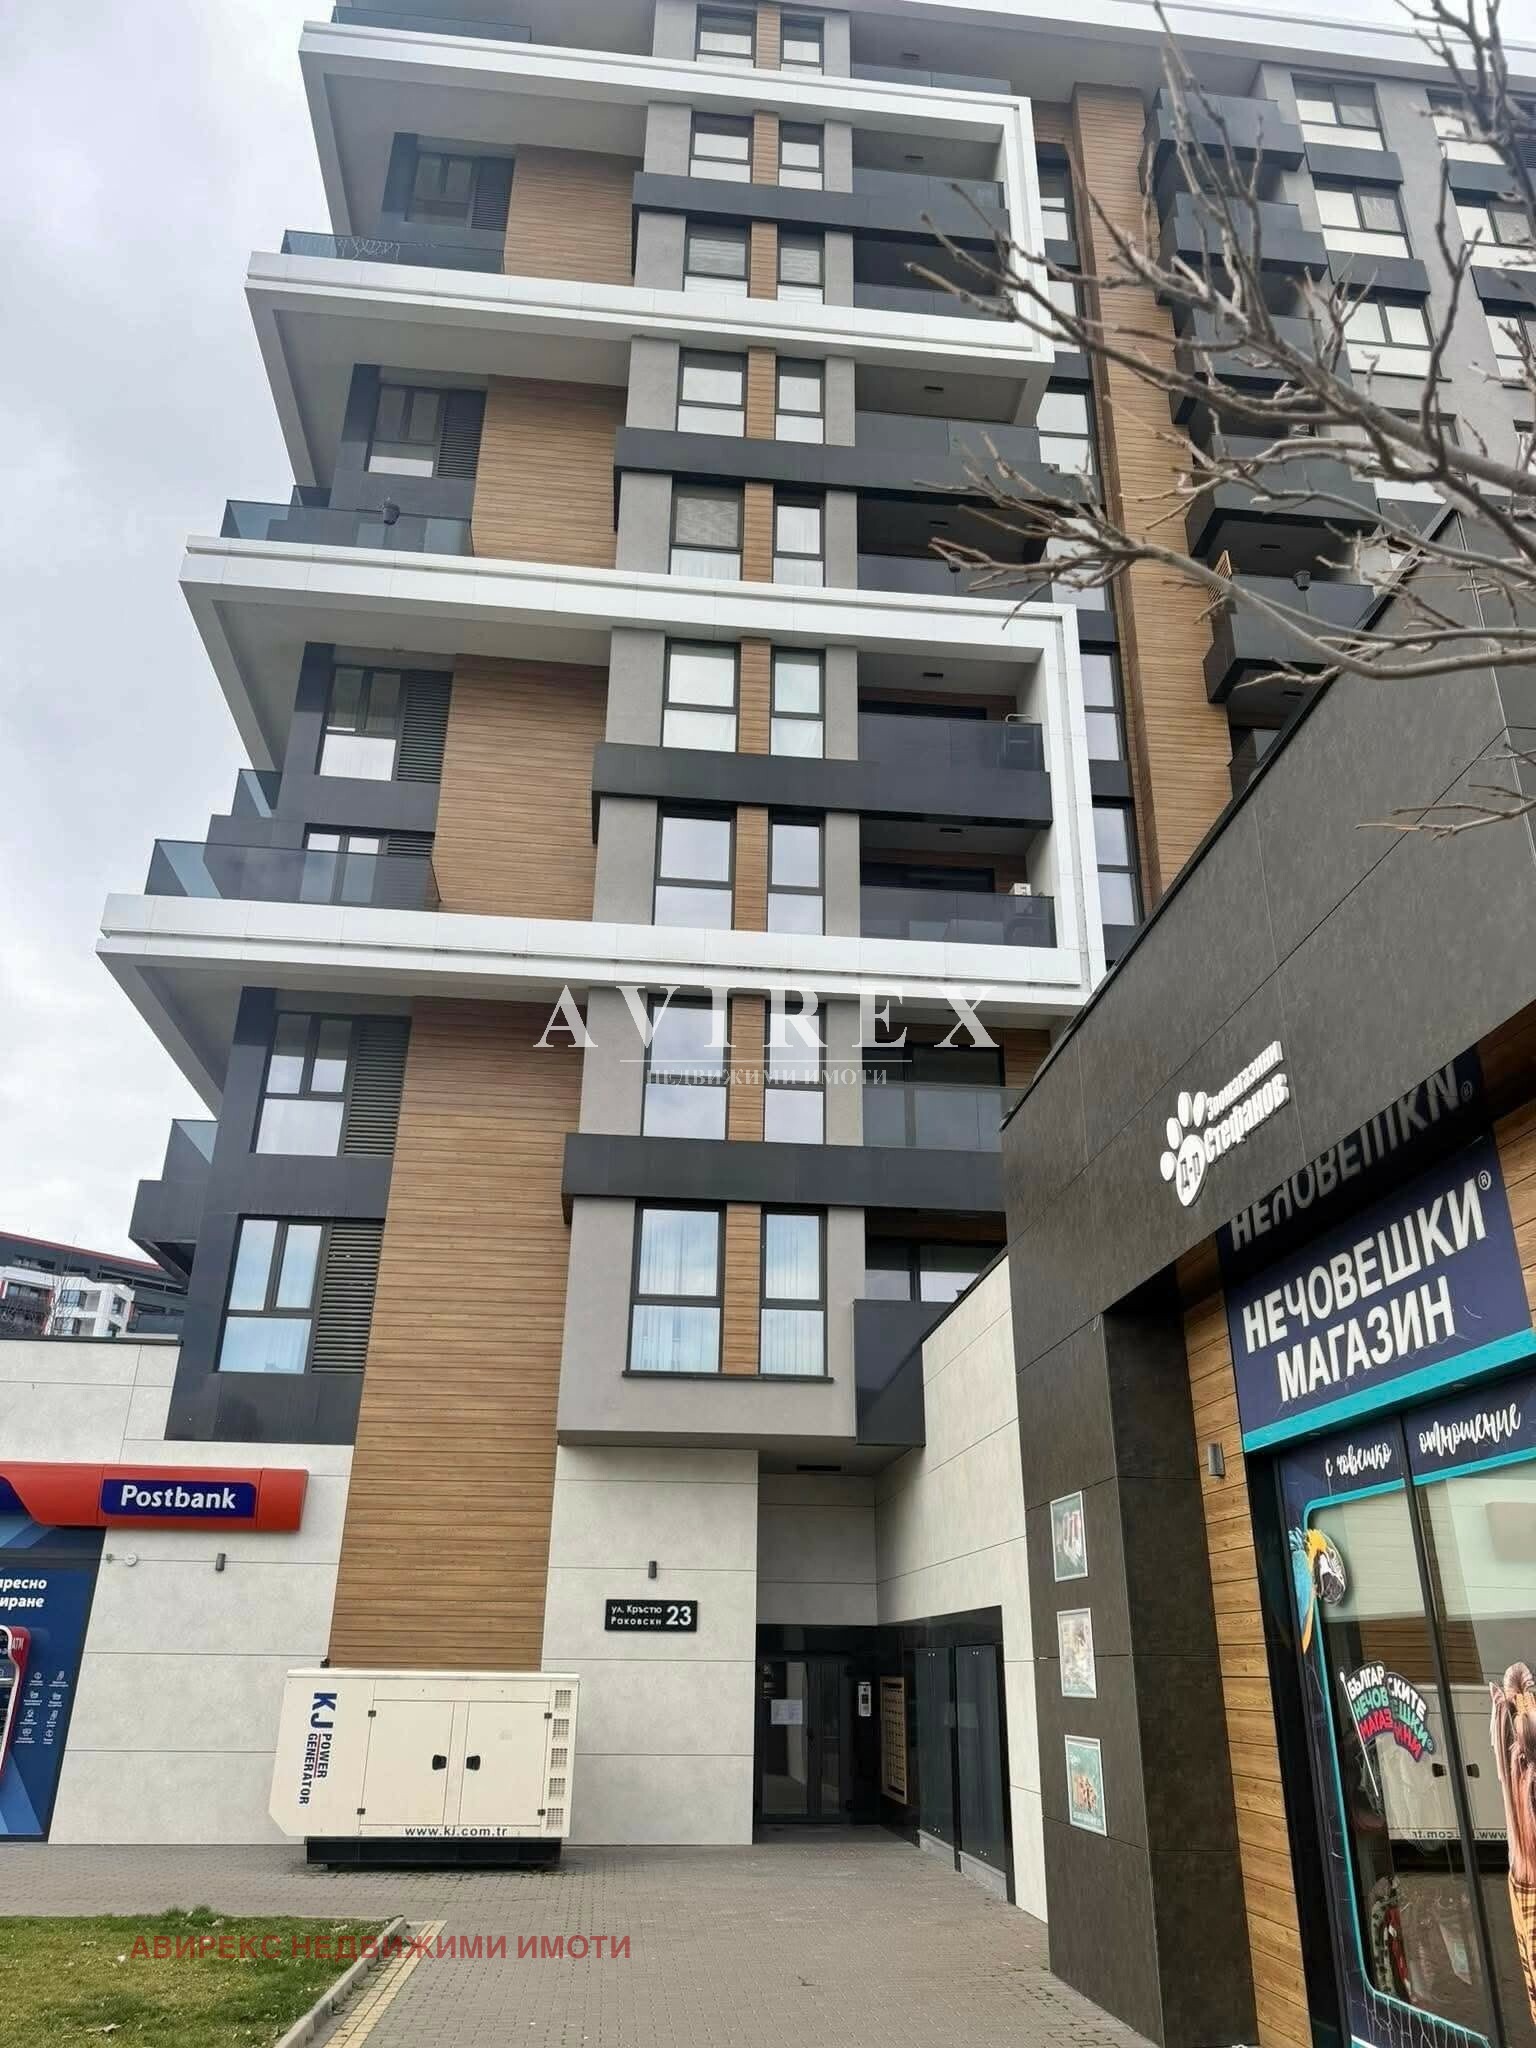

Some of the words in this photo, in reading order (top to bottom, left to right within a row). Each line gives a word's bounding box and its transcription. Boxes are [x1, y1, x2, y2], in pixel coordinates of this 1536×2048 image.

[1276, 1275, 1456, 1402] МАГАЗИН
[1336, 1442, 1392, 1477] човешко
[1418, 1403, 1521, 1457] отношение
[121, 1484, 236, 1509] Postbank
[611, 1606, 625, 1615] ул.
[626, 1605, 662, 1616] Кръстю
[666, 1605, 692, 1626] 23
[611, 1616, 662, 1625] Раковски
[310, 1692, 338, 1729] KJ
[1347, 1665, 1427, 1722] БЪЛГАРСКИТЕ
[299, 1733, 318, 1805] GENERATOR
[317, 1733, 333, 1778] POWER
[404, 1825, 508, 1837] www.kj.com.tr
